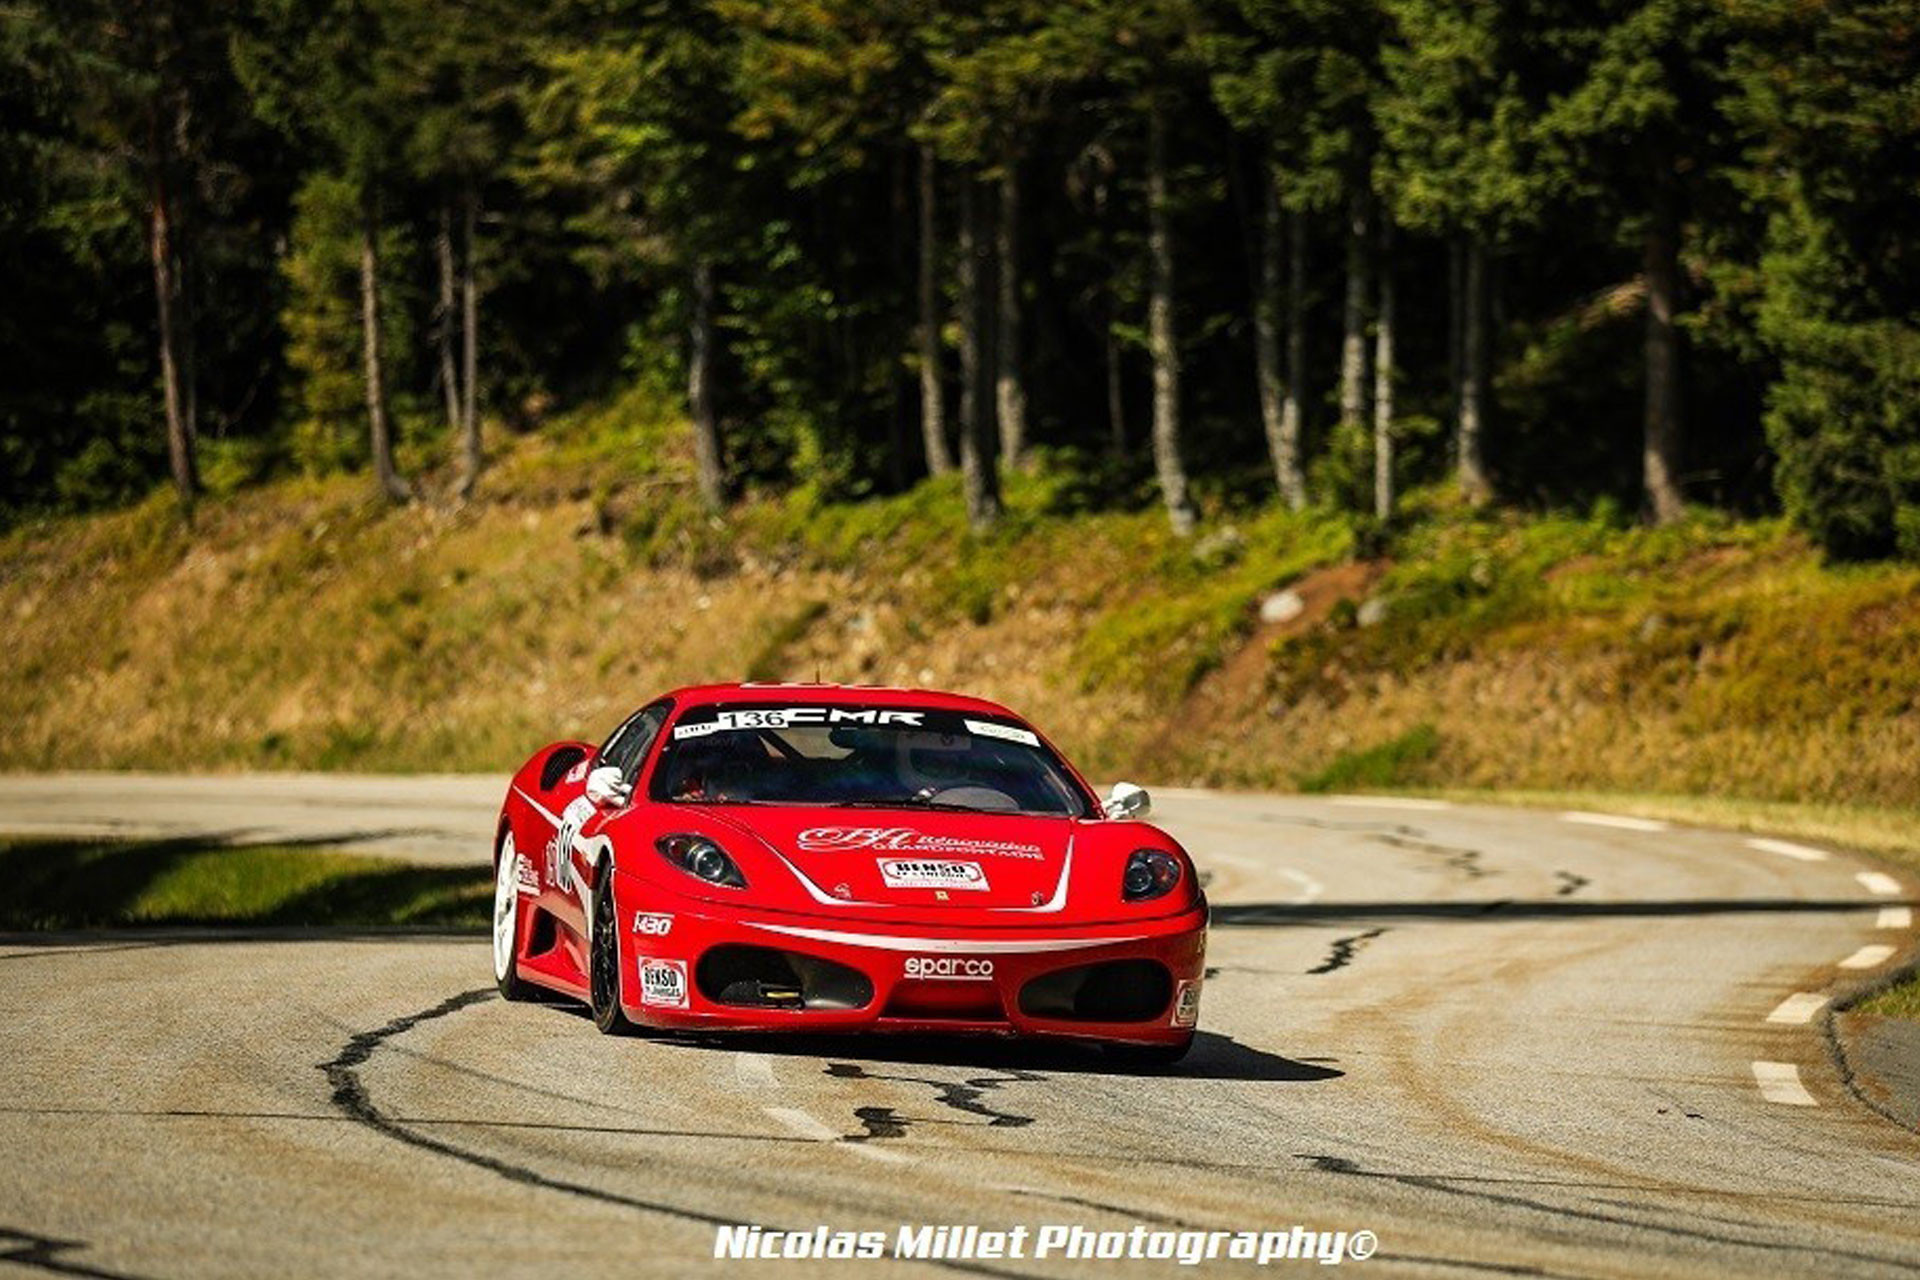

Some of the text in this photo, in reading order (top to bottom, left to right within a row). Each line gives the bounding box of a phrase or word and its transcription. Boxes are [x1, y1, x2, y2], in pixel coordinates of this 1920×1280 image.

[723, 711, 786, 728] 136
[786, 708, 925, 727] CMR
[904, 957, 994, 981] sparco
